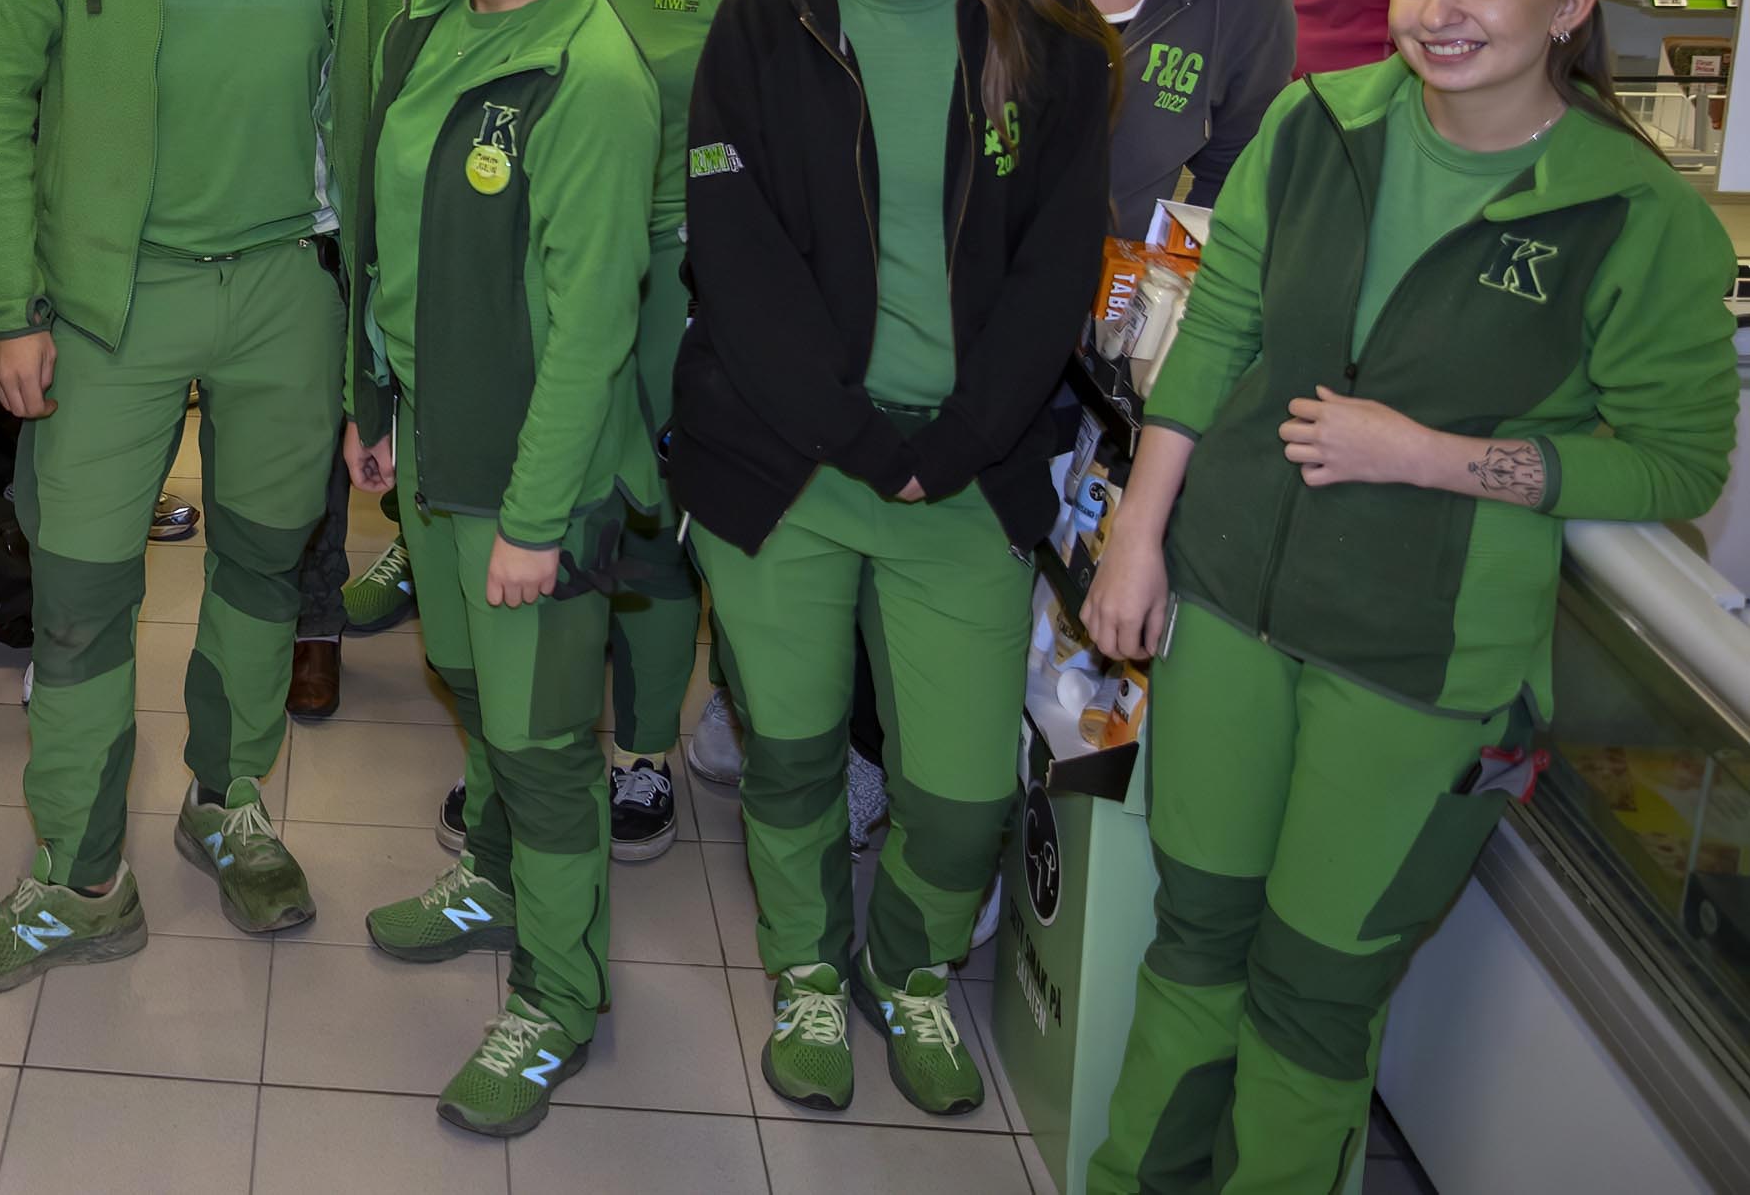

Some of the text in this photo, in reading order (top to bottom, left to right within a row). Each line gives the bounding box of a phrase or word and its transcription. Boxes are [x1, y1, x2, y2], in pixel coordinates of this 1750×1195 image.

[1141, 43, 1204, 95] F&G
[472, 100, 521, 157] K
[1153, 90, 1189, 114] 2022
[1478, 232, 1558, 304] K
